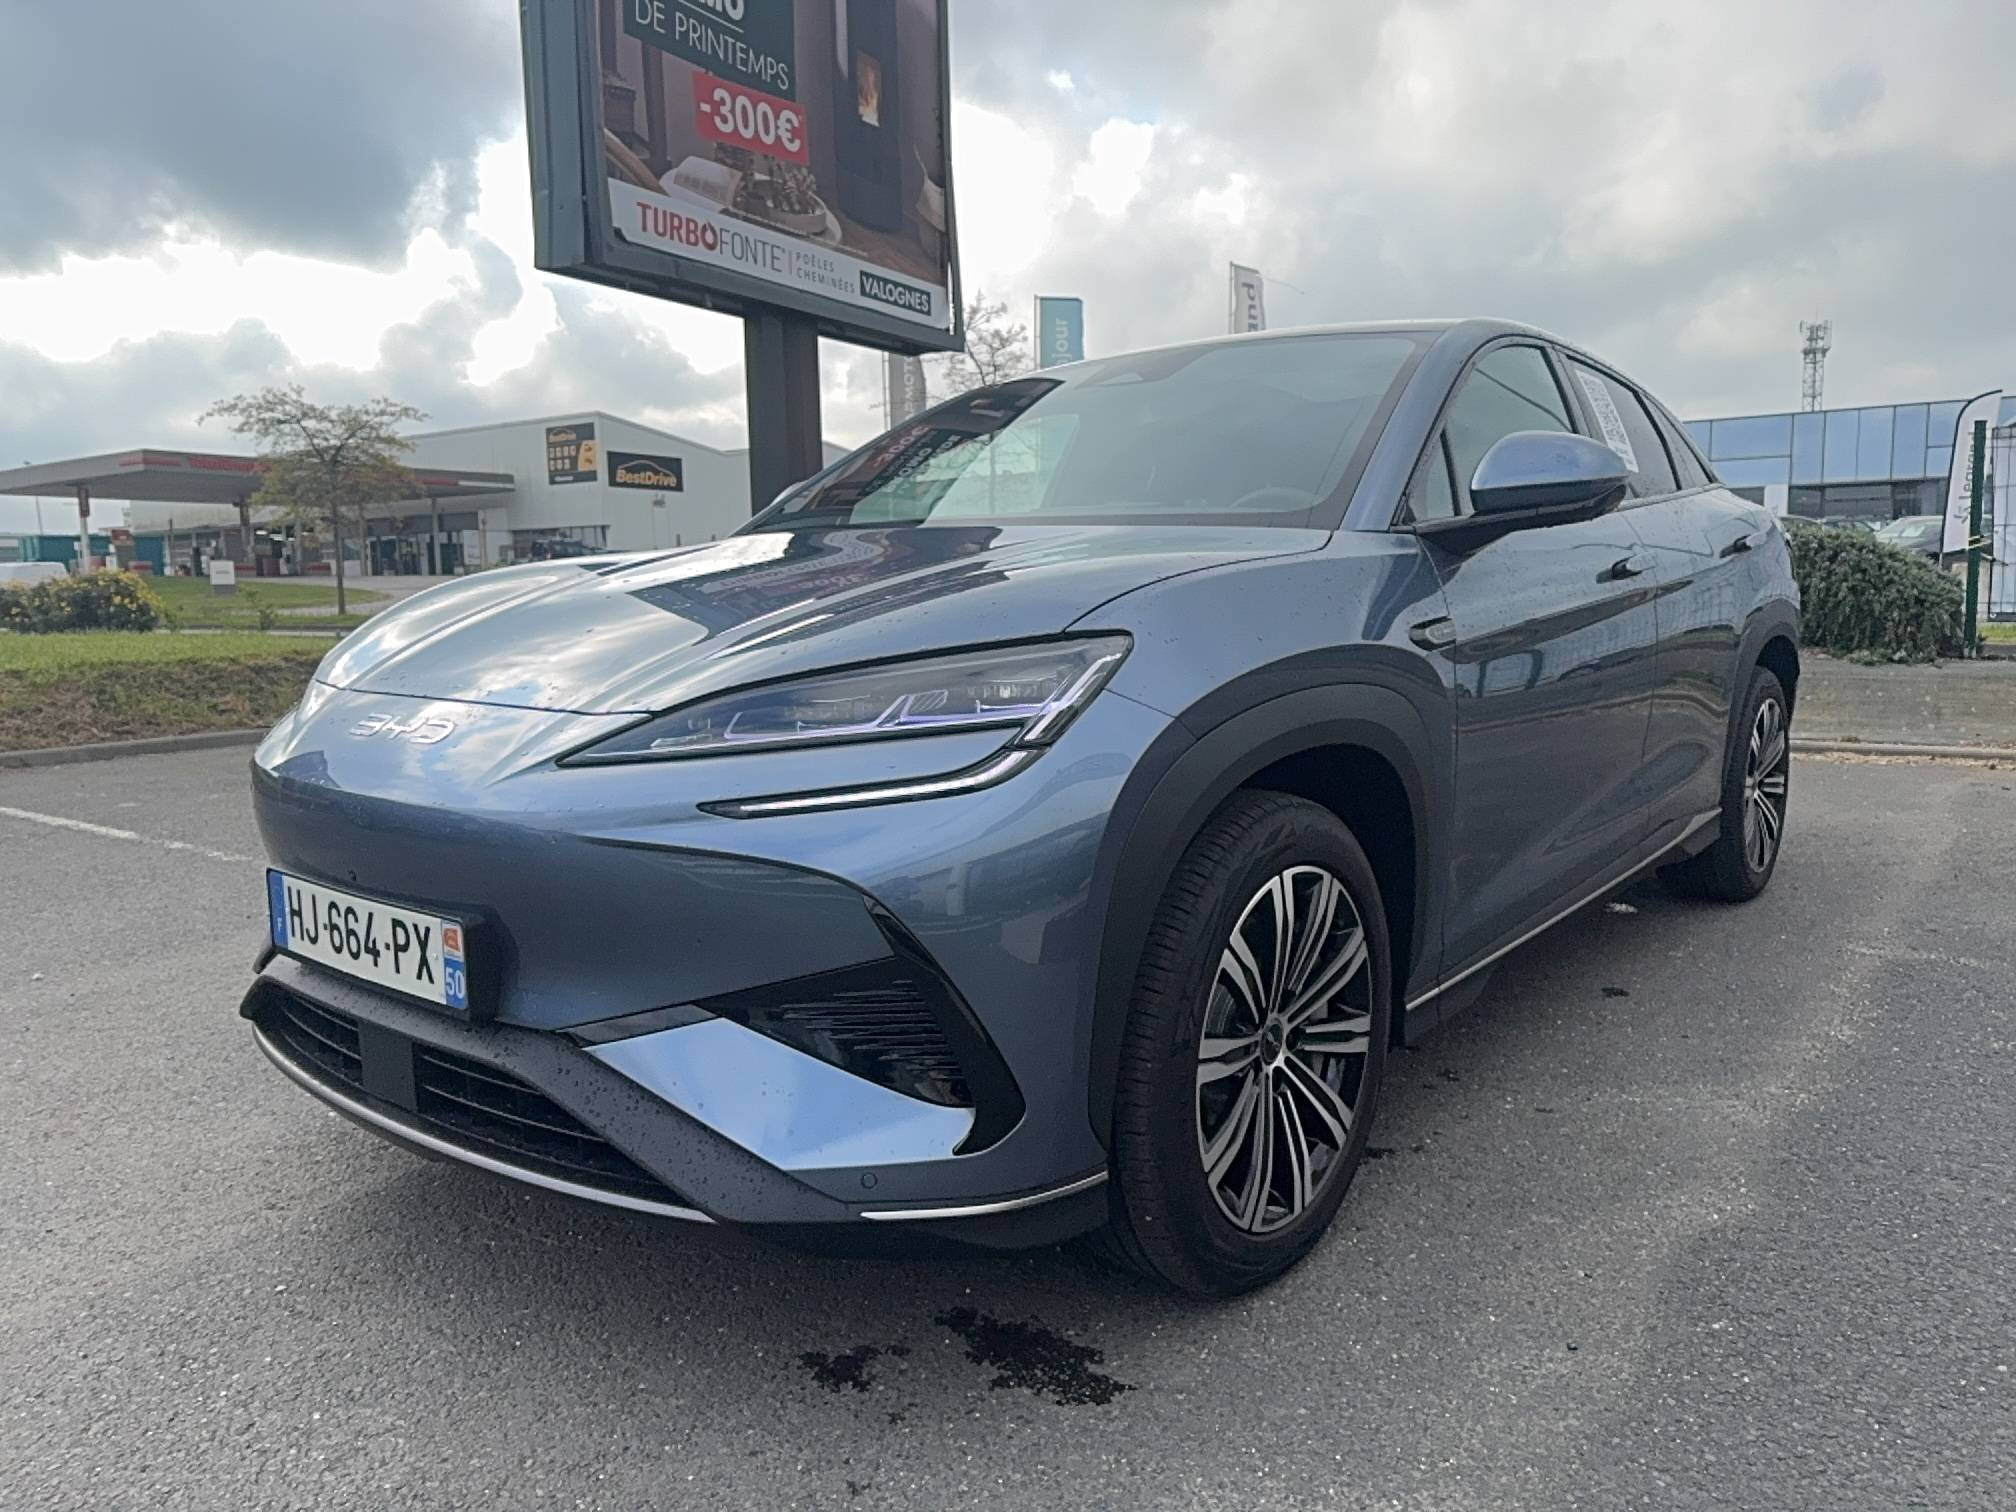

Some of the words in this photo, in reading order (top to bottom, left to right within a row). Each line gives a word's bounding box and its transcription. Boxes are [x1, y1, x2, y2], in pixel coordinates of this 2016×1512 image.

[635, 0, 666, 34] DE
[675, 12, 789, 91] PRINTEMPS
[699, 87, 801, 152] -300€
[796, 267, 855, 294] CHEMINÉES
[862, 275, 929, 312] VALOGNES
[616, 469, 677, 487] BestDrive
[287, 886, 435, 985] HJ-664-PX
[445, 967, 466, 999] 50
